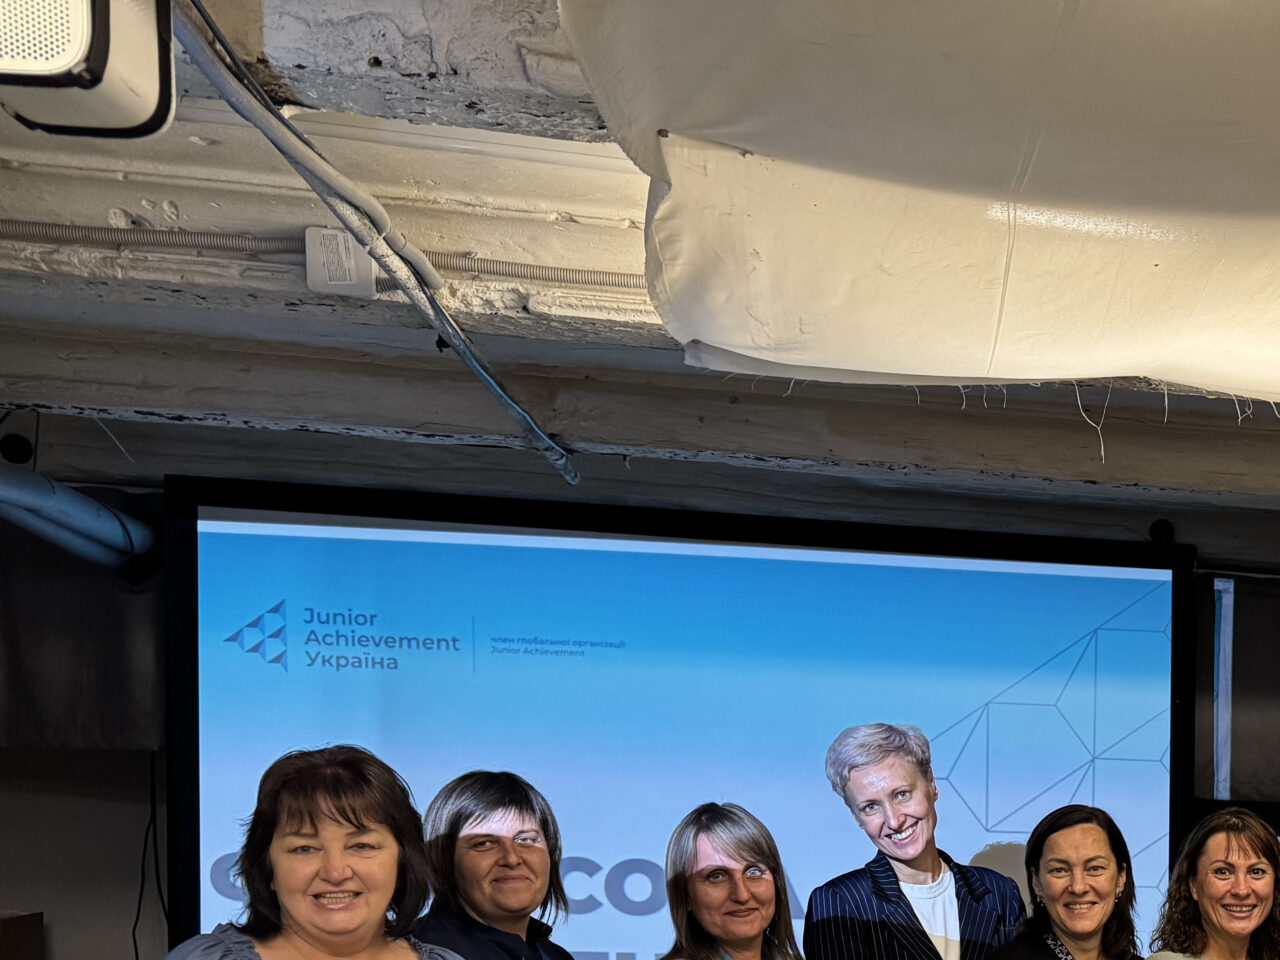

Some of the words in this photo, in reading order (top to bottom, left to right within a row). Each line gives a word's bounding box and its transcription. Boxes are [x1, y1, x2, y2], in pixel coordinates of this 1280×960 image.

[303, 607, 378, 627] Junior
[304, 629, 460, 651] Achievement
[305, 650, 399, 672] Україна
